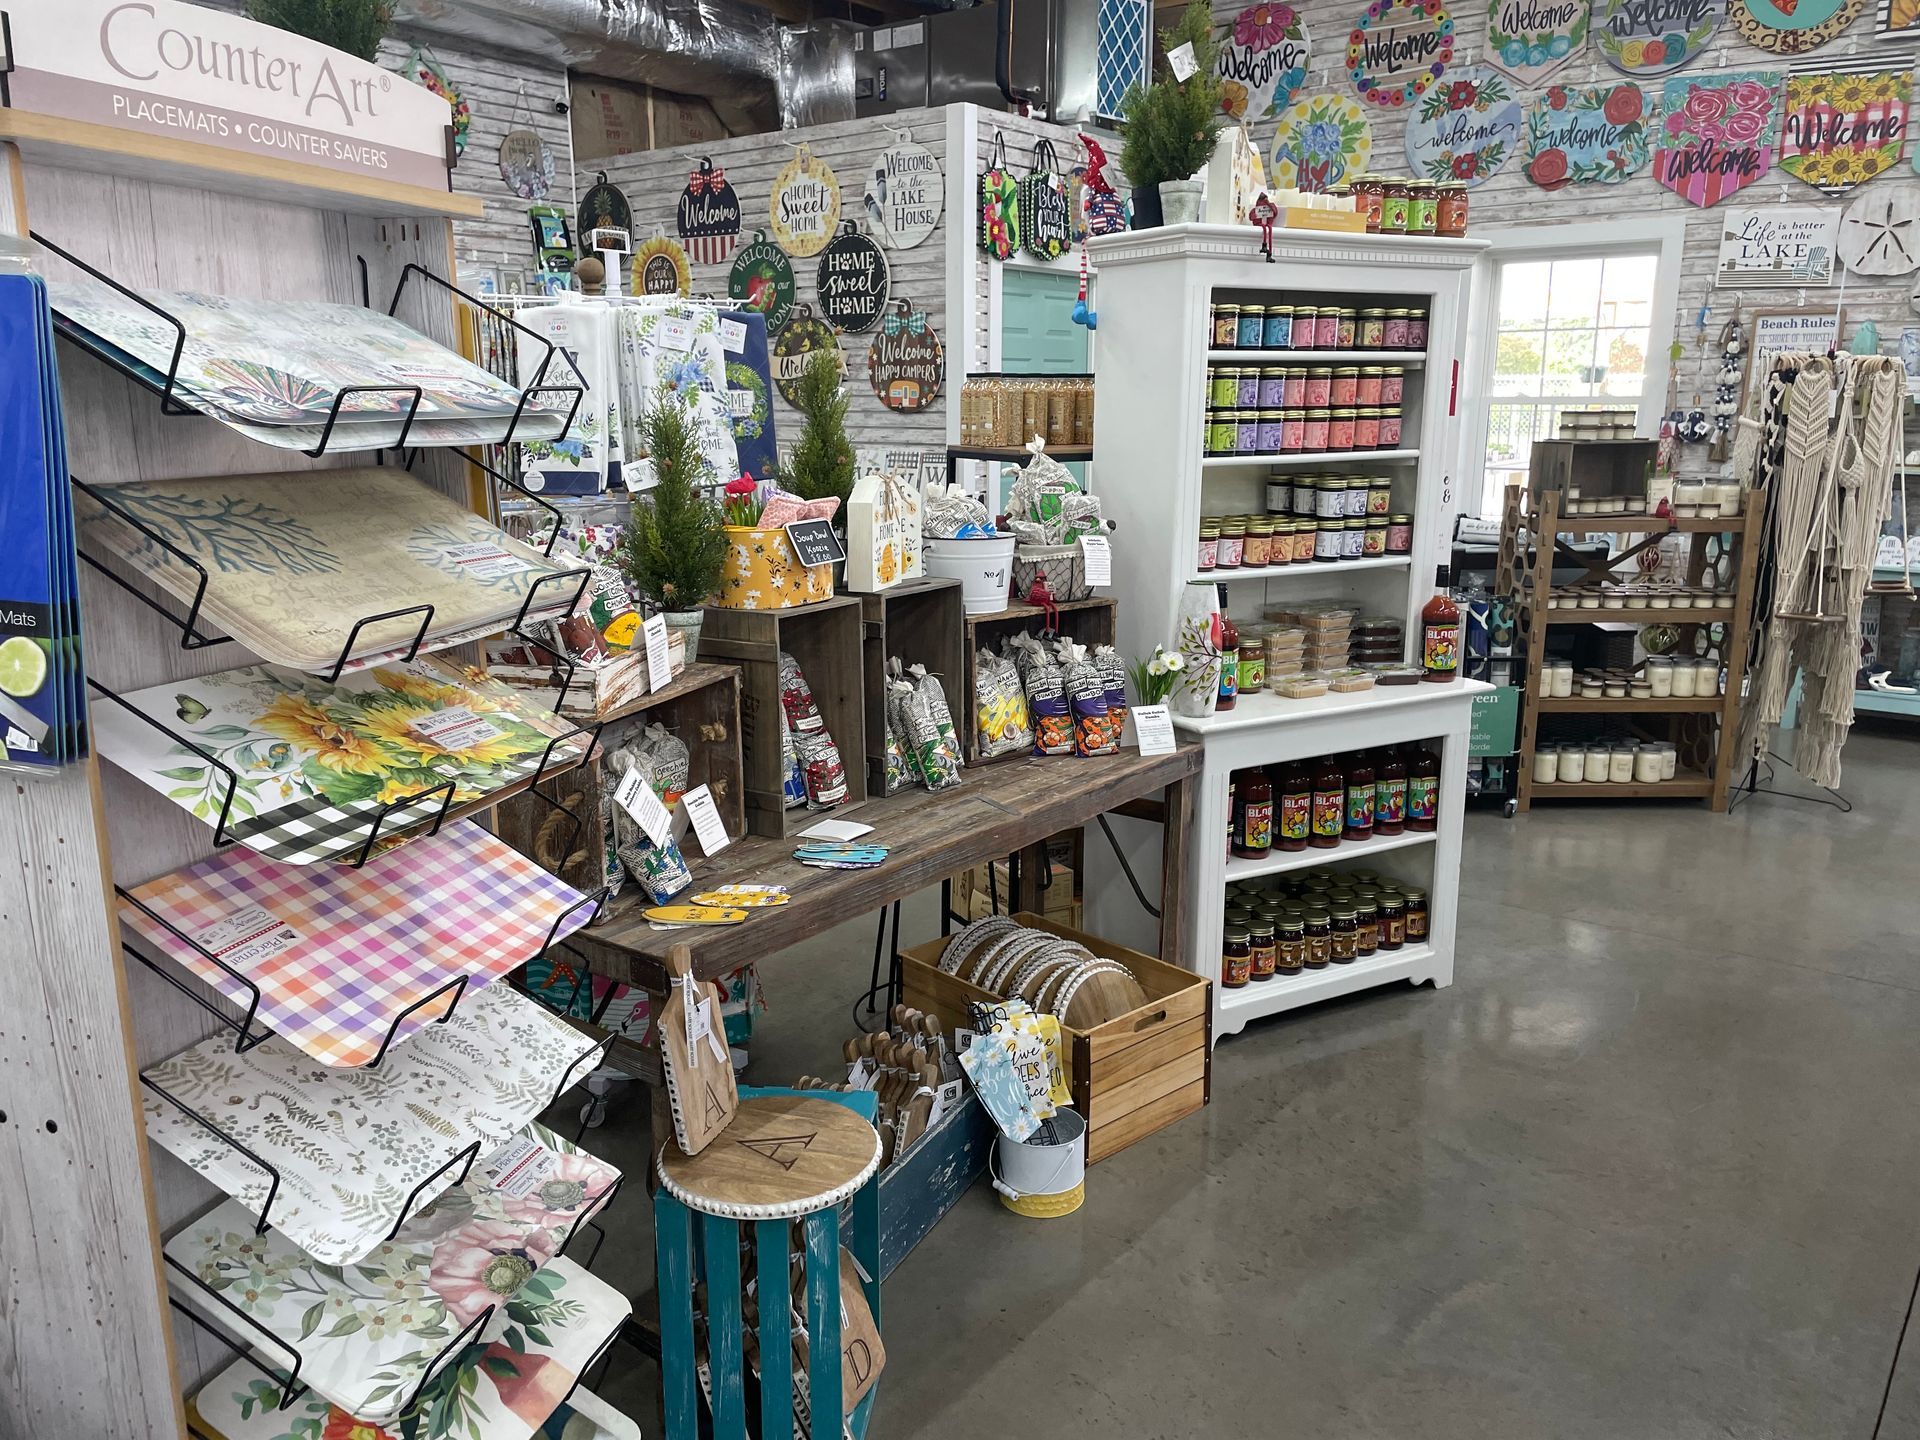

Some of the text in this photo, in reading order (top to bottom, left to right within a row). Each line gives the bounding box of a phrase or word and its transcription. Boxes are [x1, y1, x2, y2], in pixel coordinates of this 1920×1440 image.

[1502, 0, 1579, 34] Welcome
[1218, 42, 1306, 89] Welcome
[112, 95, 388, 170] PLACEMATS COUNTER SAVERS
[1787, 112, 1905, 150] Welcome
[781, 186, 830, 223] Sweet
[790, 183, 817, 201] HOME
[892, 189, 926, 206] LAKE
[681, 194, 738, 229] Welcome
[791, 215, 818, 233] HOME
[1734, 216, 1826, 247] Life is better
[1794, 232, 1813, 240] the
[649, 258, 662, 271] THIS
[735, 245, 786, 272] WELCOME
[1741, 243, 1808, 259] LAKE
[648, 279, 674, 290] HAPPY
[817, 263, 888, 295] sweet
[1760, 317, 1836, 329] Beach Rules
[878, 334, 935, 364] Welcome
[875, 364, 936, 383] HAPPY CAMPERS
[795, 531, 814, 543] Soup
[0, 610, 36, 627] Mats
[230, 937, 283, 965] Placemat
[703, 1080, 728, 1136] A
[496, 1141, 531, 1171] Placemat
[736, 1131, 818, 1171] A
[843, 1338, 872, 1390] D
